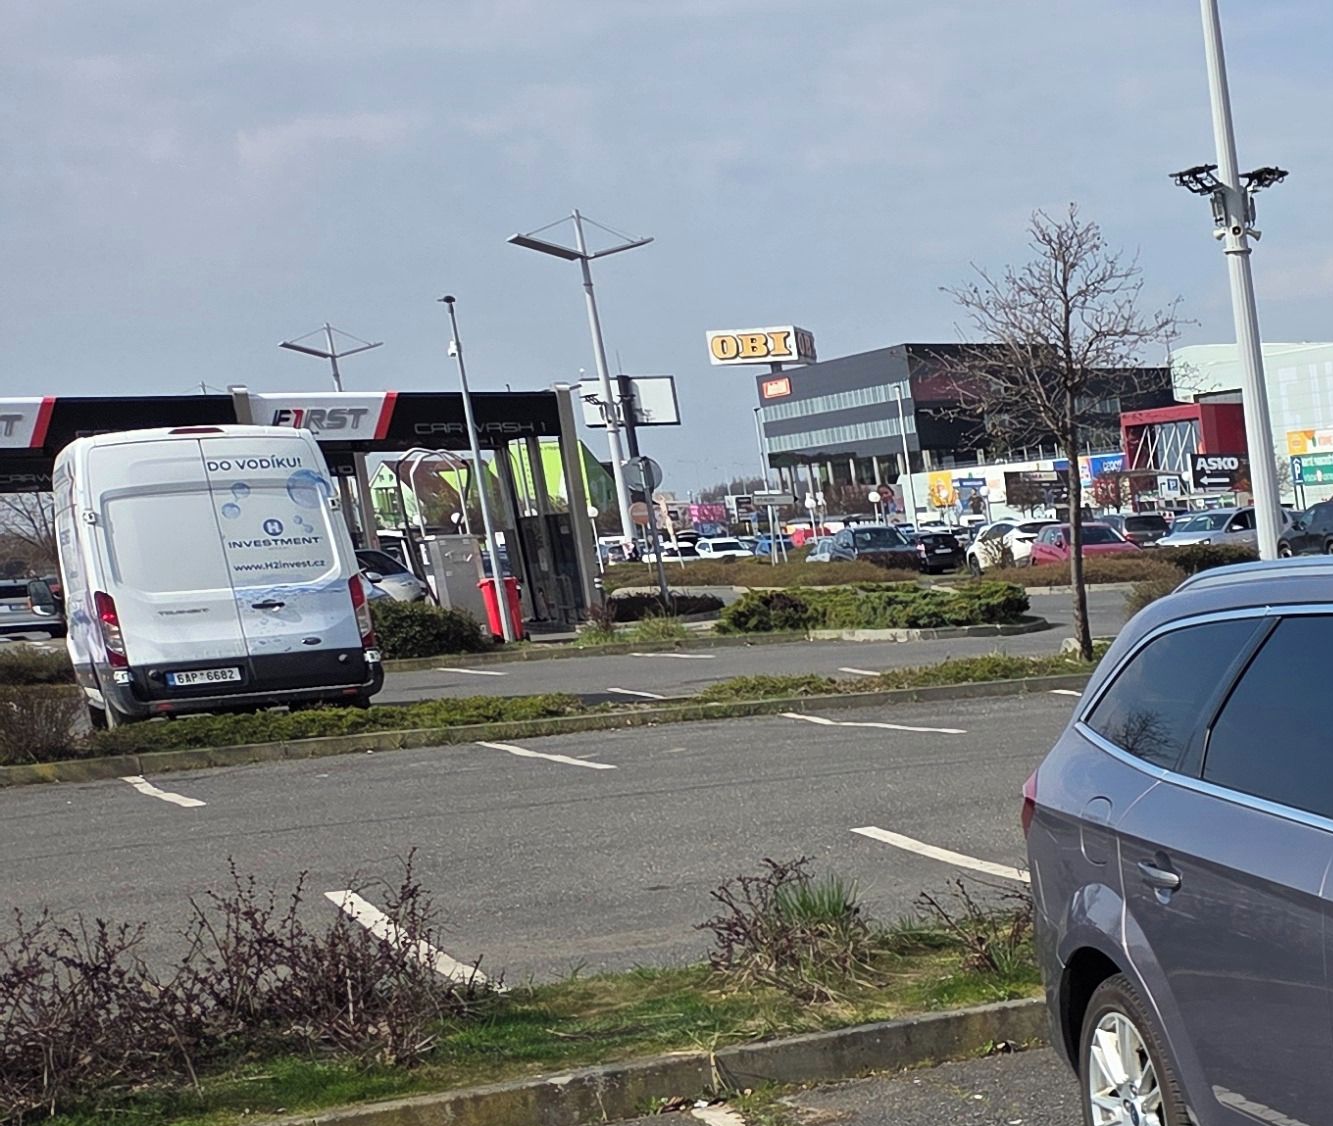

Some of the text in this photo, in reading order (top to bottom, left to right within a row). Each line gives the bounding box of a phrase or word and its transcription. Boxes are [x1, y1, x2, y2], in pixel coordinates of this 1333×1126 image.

[711, 331, 793, 360] OBI
[207, 454, 302, 471] DO VODÍKU!
[1196, 457, 1239, 471] ASKO
[228, 536, 320, 549] INVESTMENT
[177, 669, 234, 684] 6AP 6682
